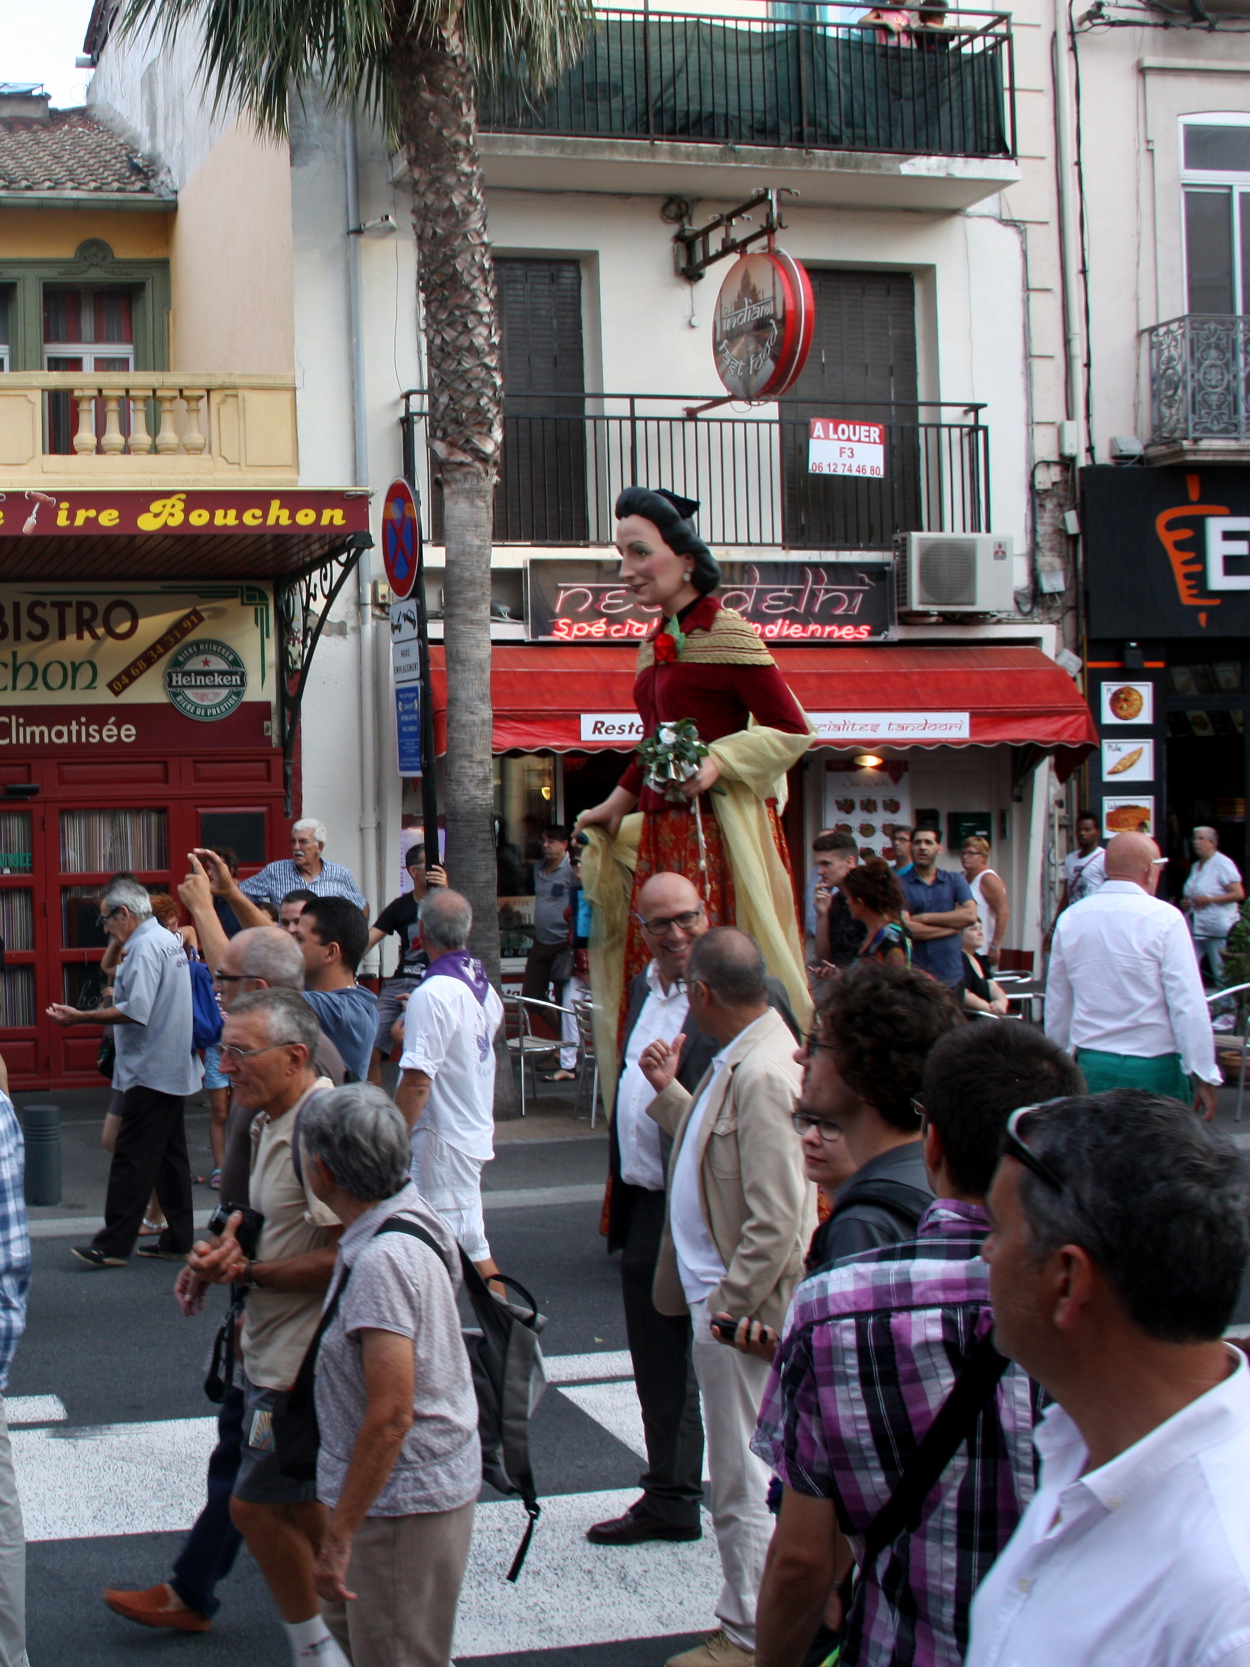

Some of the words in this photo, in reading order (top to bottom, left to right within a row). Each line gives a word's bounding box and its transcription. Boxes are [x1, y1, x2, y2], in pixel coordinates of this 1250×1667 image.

[812, 421, 825, 438] A
[828, 422, 881, 444] LOUER
[839, 446, 855, 459] F3
[811, 462, 824, 473] 06
[827, 462, 838, 473] 12
[841, 463, 853, 474] 74
[855, 464, 867, 475] 46
[869, 465, 881, 476] 80
[136, 493, 347, 532] Bouchon
[112, 674, 129, 692] 04
[130, 659, 147, 676] 68
[147, 644, 165, 661] 34
[165, 630, 181, 646] 31
[182, 614, 199, 630] 91
[199, 643, 235, 662] HEINEKEN
[394, 662, 419, 675] EMPLACEMENT
[171, 672, 242, 686] Heineken
[207, 694, 238, 716] PRESTIGE
[887, 718, 964, 732] tandoori
